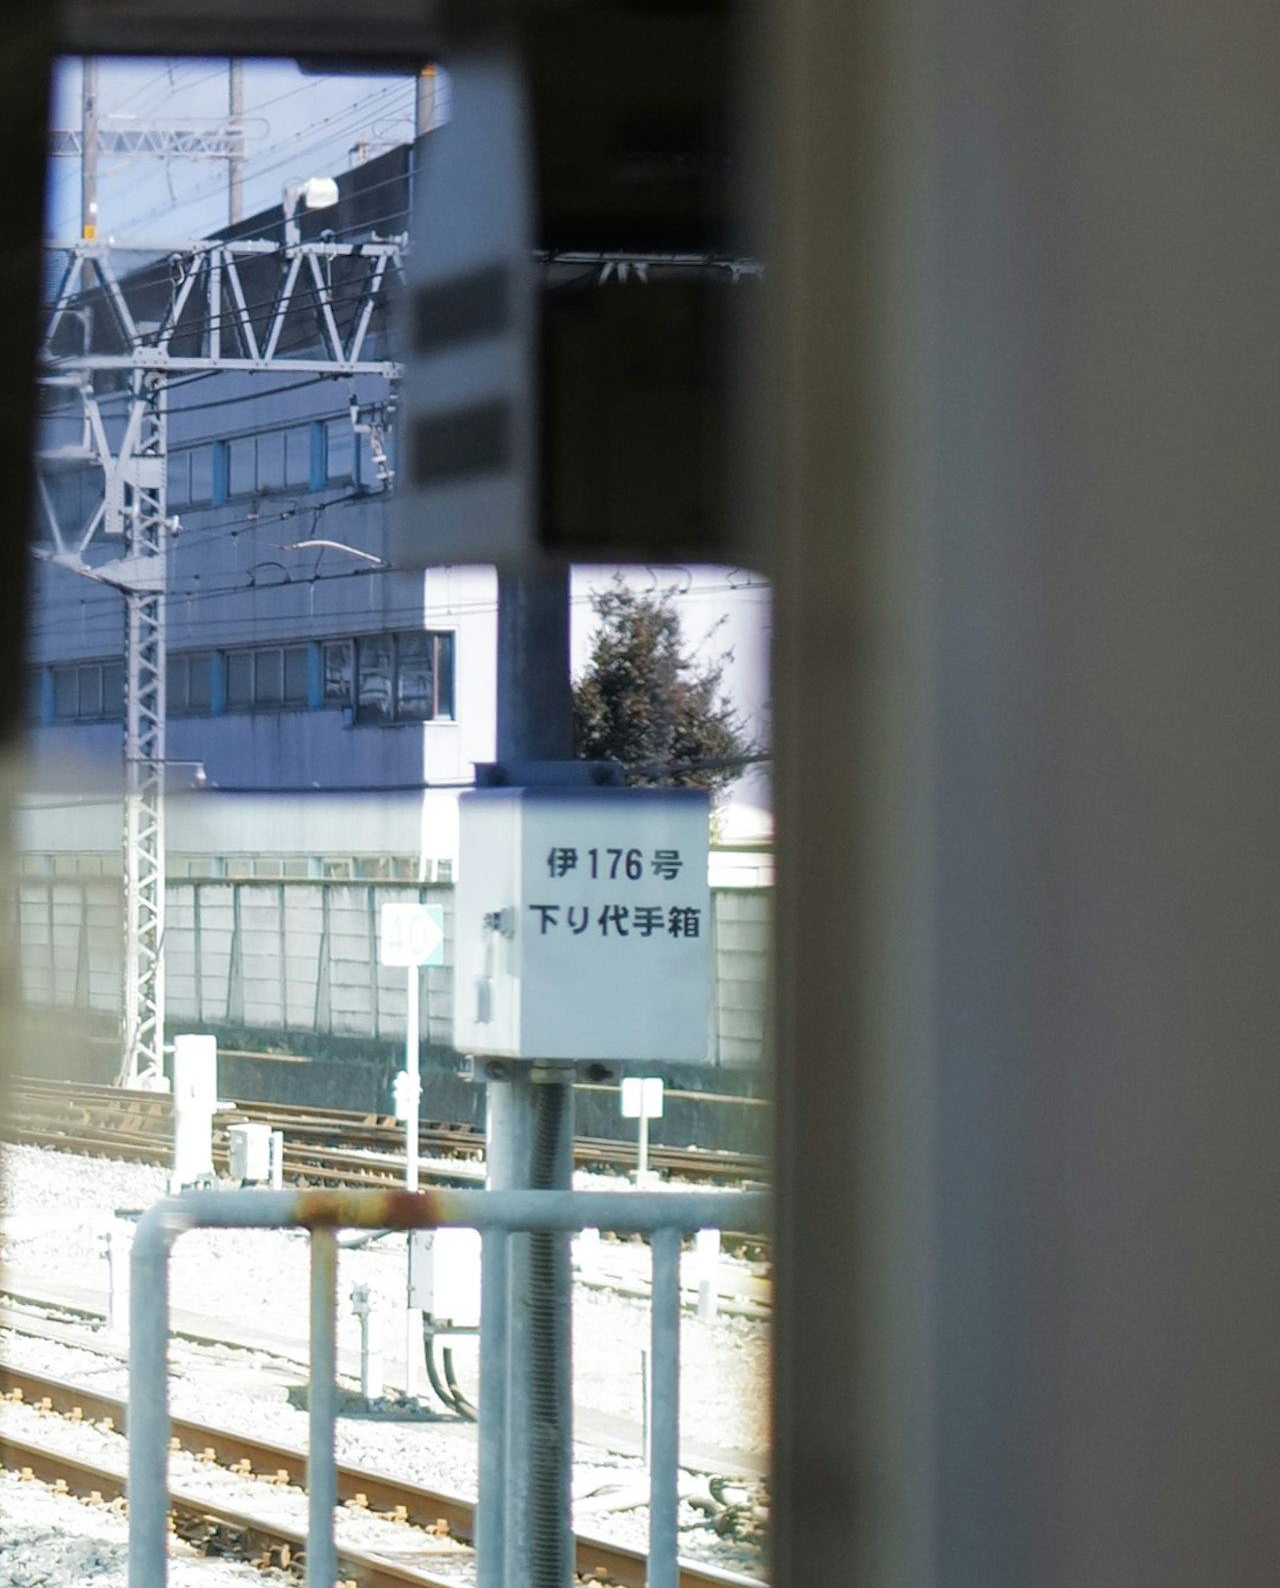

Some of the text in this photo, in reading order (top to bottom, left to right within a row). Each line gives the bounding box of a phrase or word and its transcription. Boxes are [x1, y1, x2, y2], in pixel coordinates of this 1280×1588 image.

[546, 847, 683, 881] 伊176号
[388, 915, 428, 955] 40
[528, 904, 702, 939] 下り代手箱
